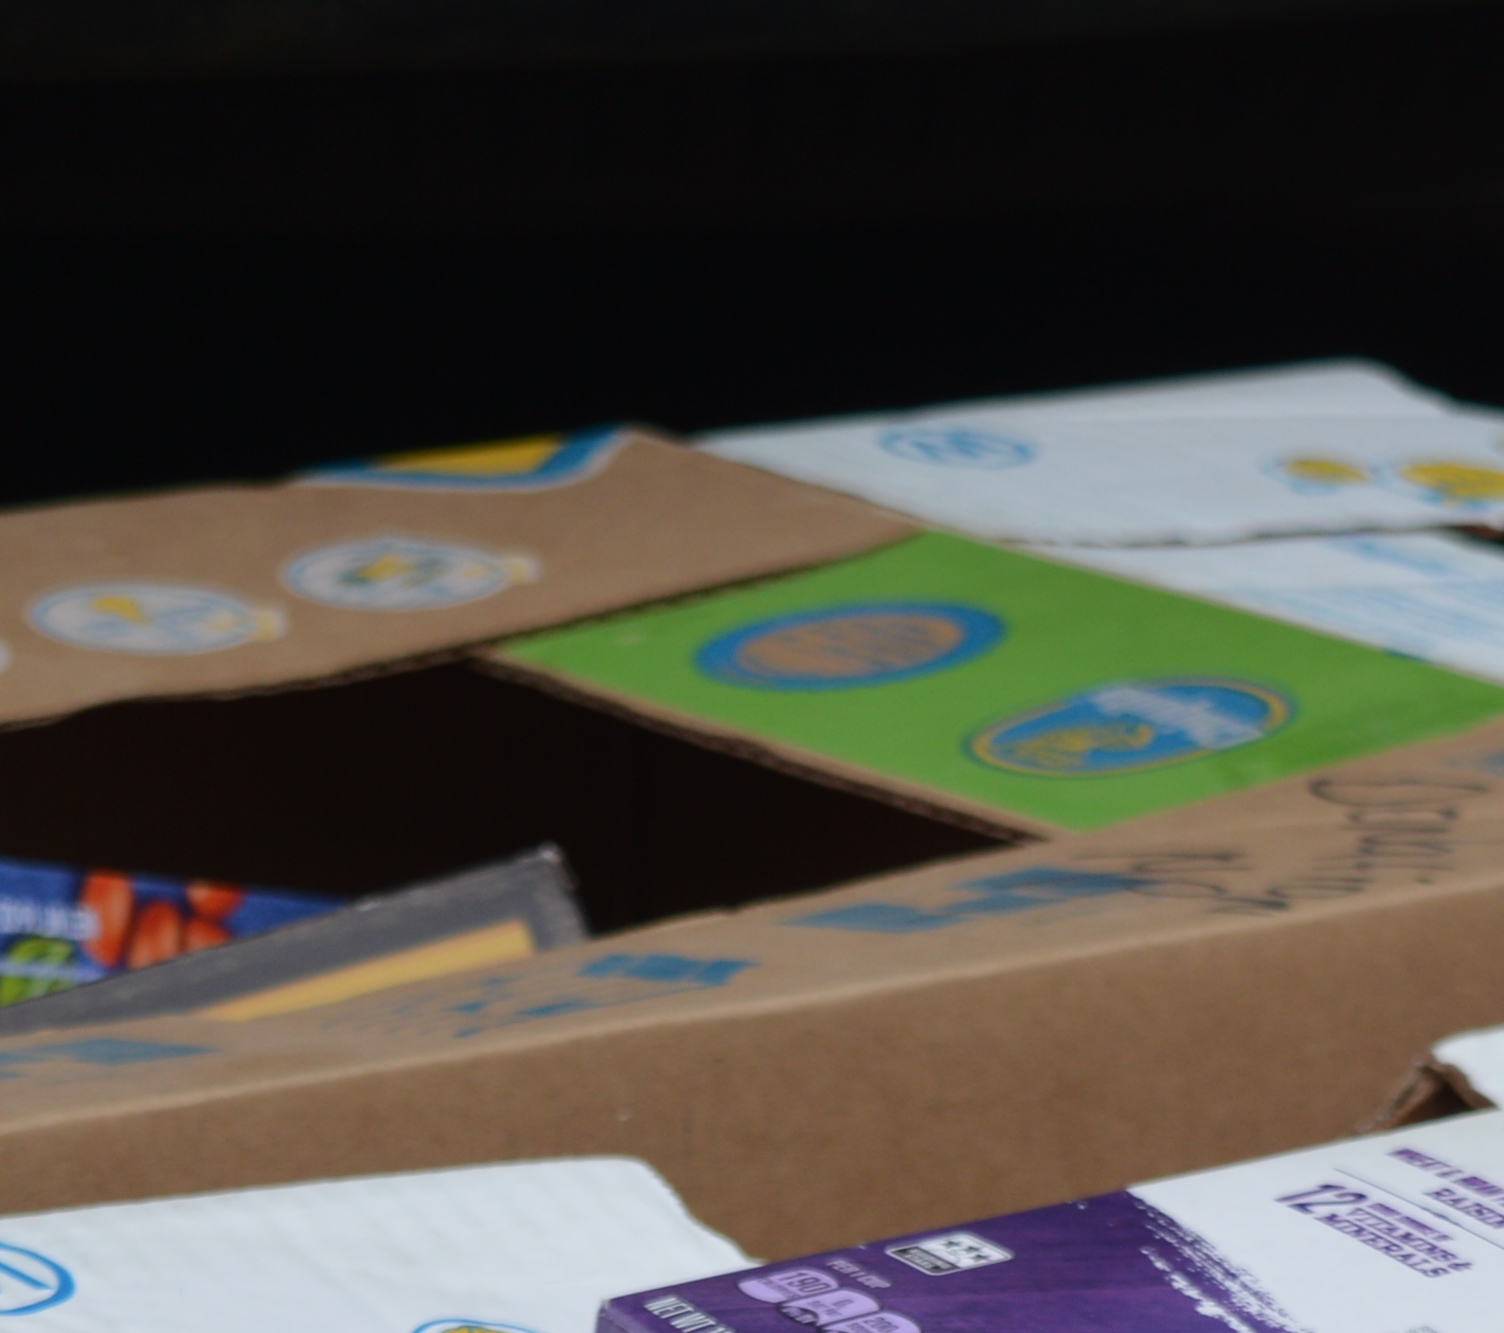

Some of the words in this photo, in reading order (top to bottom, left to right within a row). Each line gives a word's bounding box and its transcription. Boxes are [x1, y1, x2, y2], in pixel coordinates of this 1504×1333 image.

[1313, 1213, 1453, 1279] MINERALS
[643, 1296, 697, 1320] NET
[669, 1311, 718, 1333] WT
